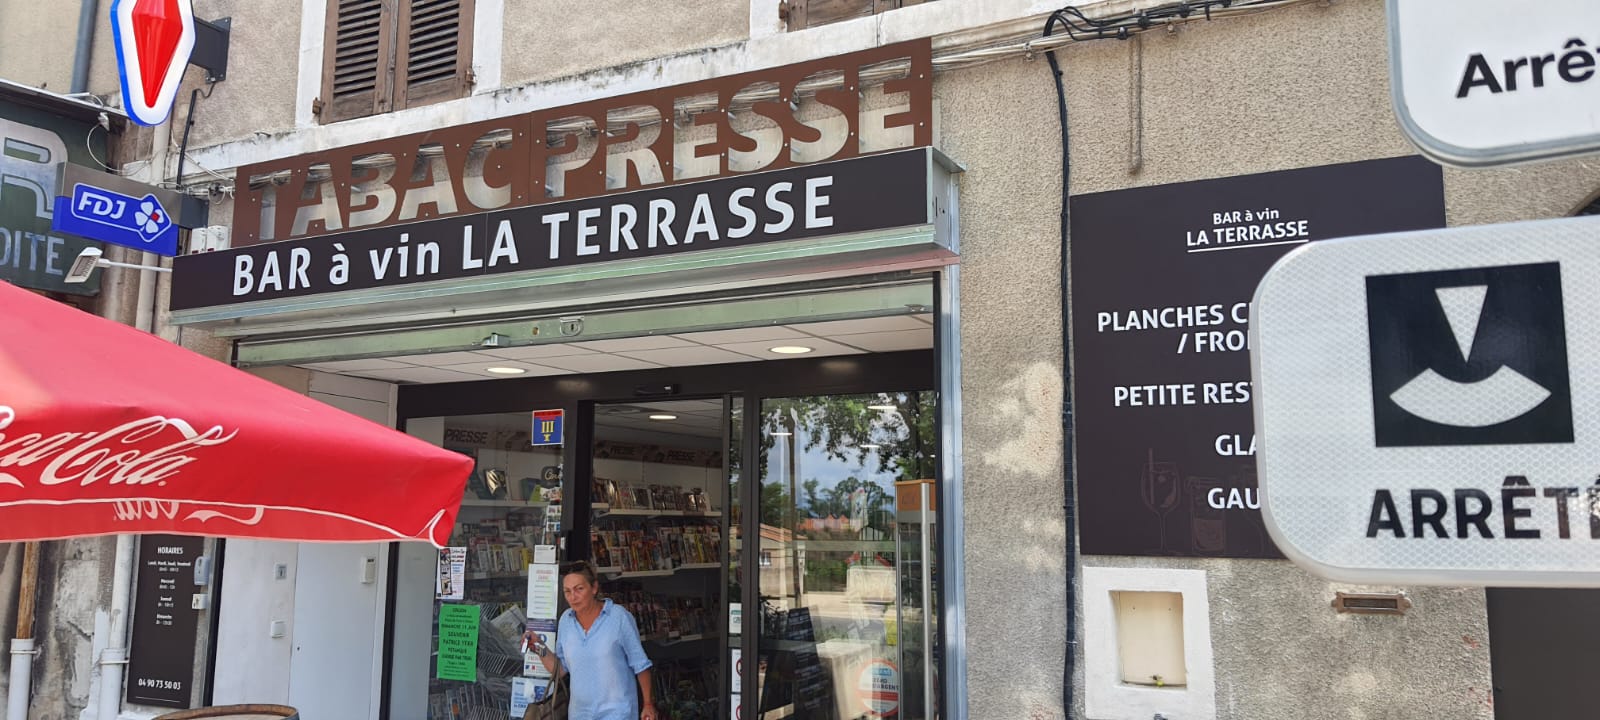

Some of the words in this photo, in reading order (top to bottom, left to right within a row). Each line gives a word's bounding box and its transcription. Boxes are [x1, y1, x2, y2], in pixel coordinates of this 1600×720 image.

[1456, 37, 1600, 98] Arrê
[250, 128, 513, 241] TABAC
[545, 56, 915, 199] PRESSE
[78, 191, 126, 220] FDJ
[1213, 211, 1242, 225] BAR
[1245, 209, 1254, 222] à
[1256, 207, 1280, 221] vin
[232, 247, 311, 296] BAR
[329, 243, 350, 284] à
[369, 233, 440, 280] vin
[462, 219, 519, 270] LA
[541, 175, 834, 259] TERRASSE
[1186, 228, 1209, 246] LA
[1213, 220, 1309, 244] TERRASSE
[1097, 304, 1224, 332] PLANCHES
[1231, 302, 1252, 324] C
[1194, 330, 1251, 353] FRO
[1114, 383, 1196, 407] PETITE
[1203, 382, 1253, 405] RES
[157, 546, 184, 555] HORAIRES
[138, 678, 146, 687] 04
[147, 678, 155, 688] 90
[155, 679, 164, 689] 73
[164, 680, 173, 689] 50
